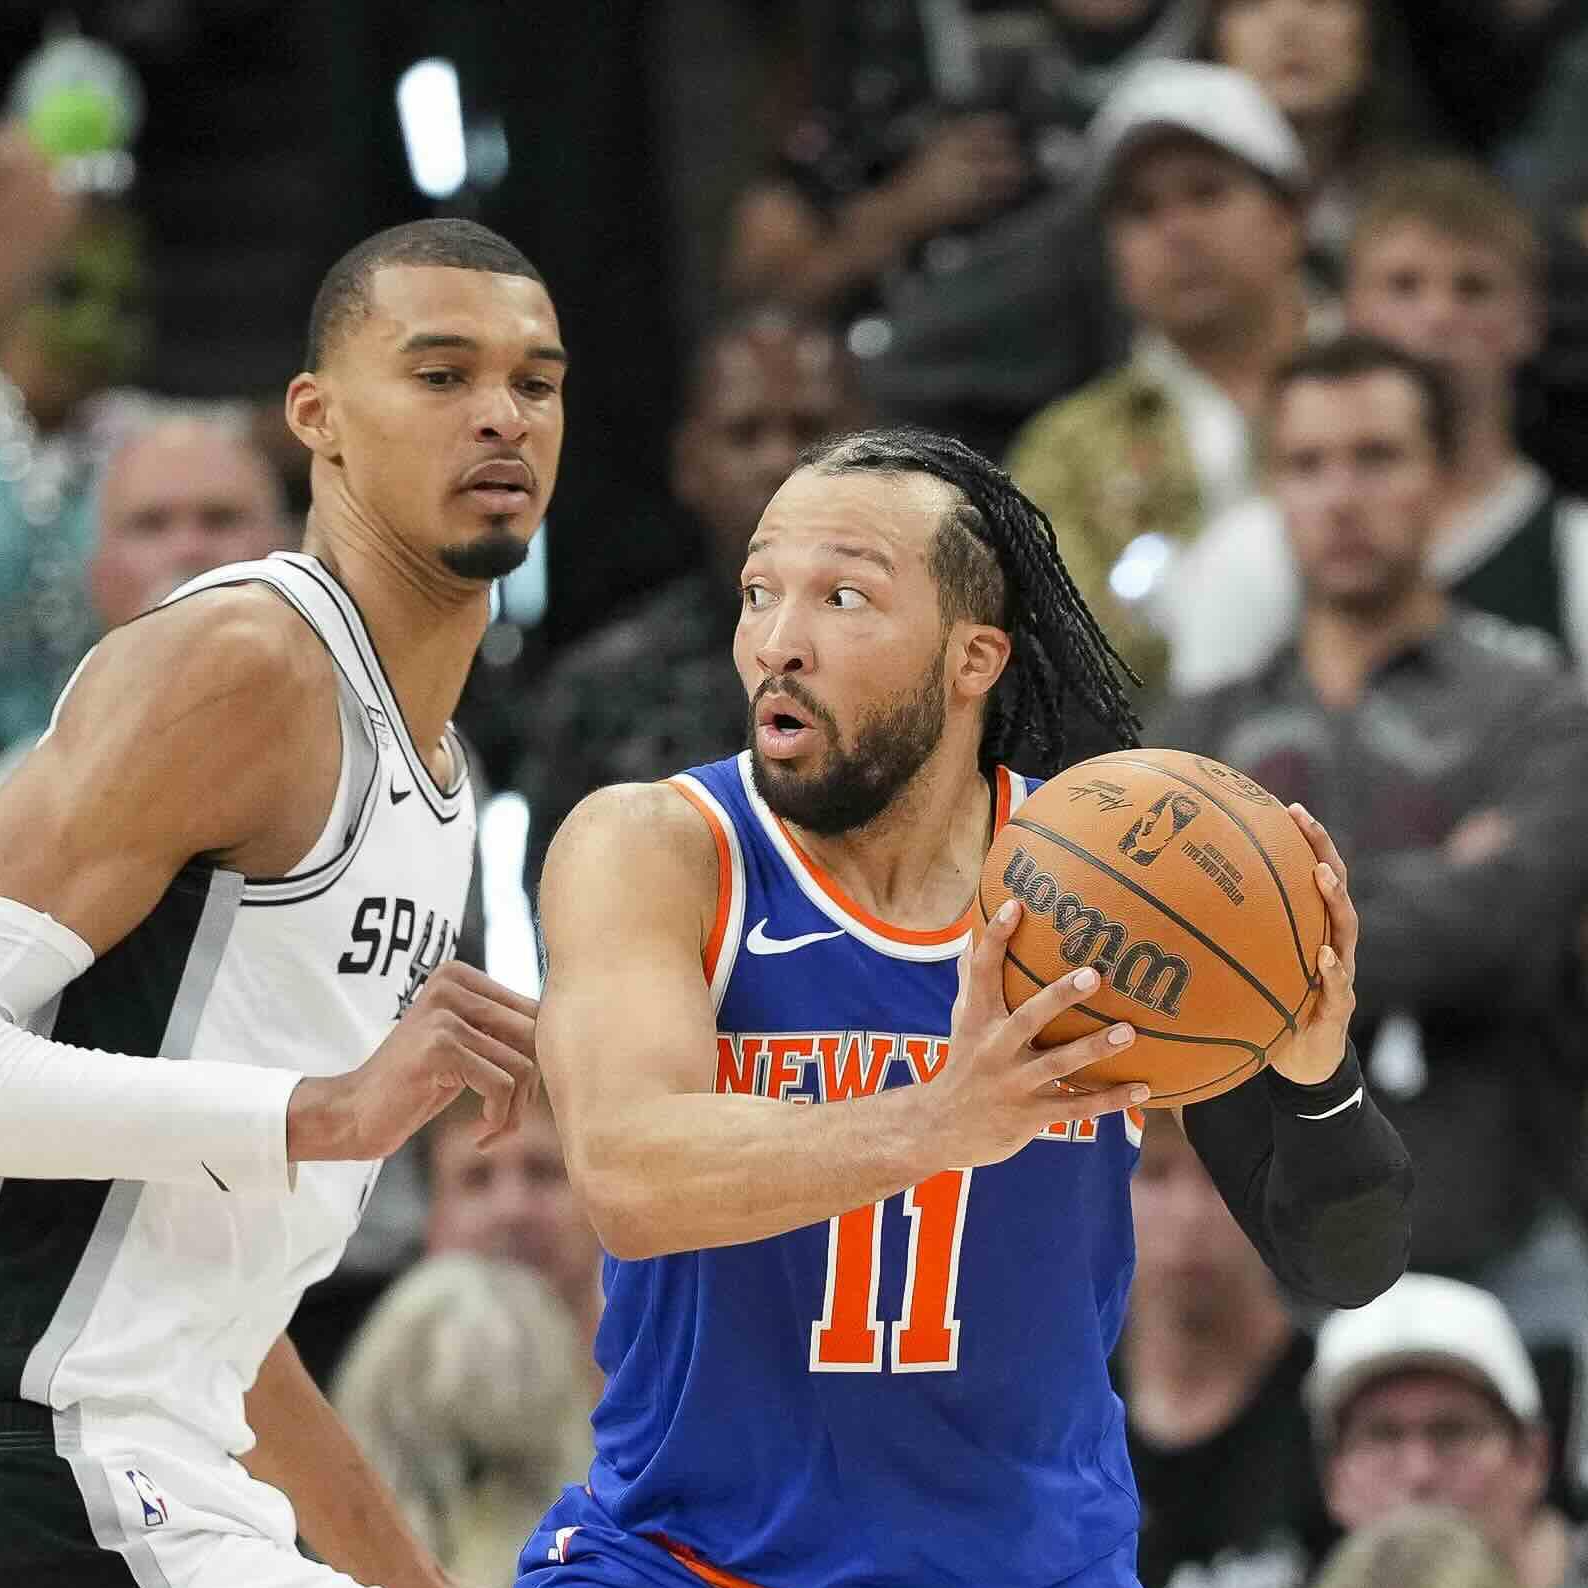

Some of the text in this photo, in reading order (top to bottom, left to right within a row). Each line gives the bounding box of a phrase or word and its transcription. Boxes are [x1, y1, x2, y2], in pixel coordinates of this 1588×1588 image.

[1003, 845, 1193, 1020] Wilson
[716, 1032, 894, 1104] NEW
[808, 1166, 972, 1374] 11
